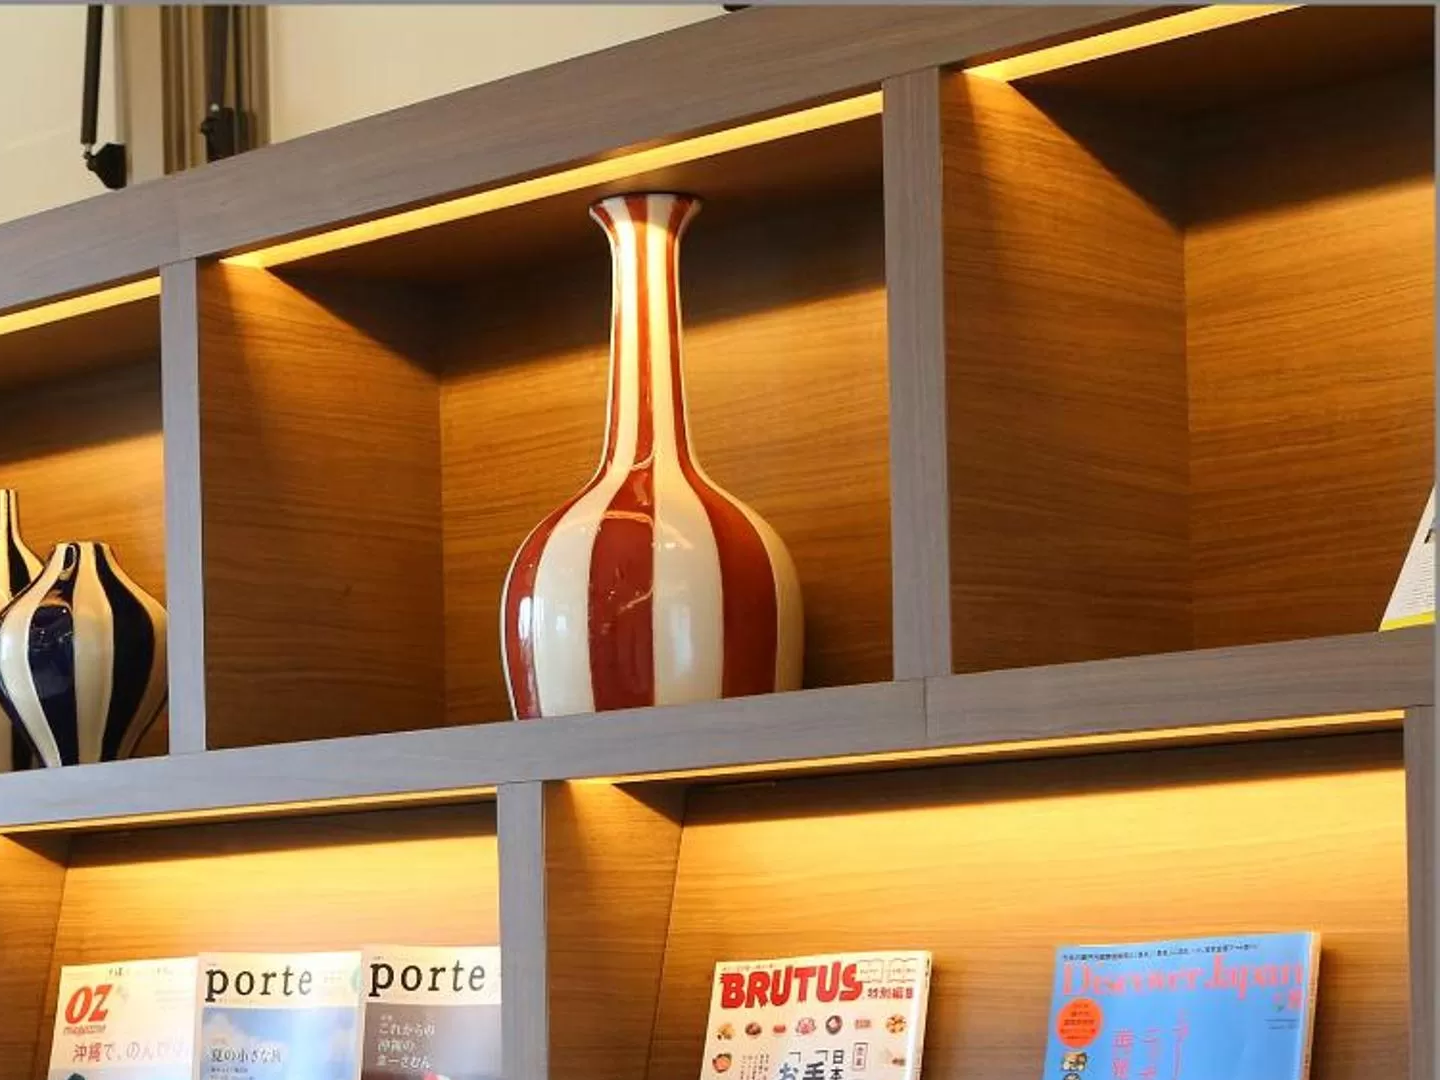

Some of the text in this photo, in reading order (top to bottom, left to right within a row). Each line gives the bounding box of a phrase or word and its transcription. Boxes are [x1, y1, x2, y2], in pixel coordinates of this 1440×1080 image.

[205, 965, 312, 1002] porte
[368, 960, 486, 997] porte
[720, 961, 863, 1010] BRUTUS
[64, 984, 113, 1025] OZ
